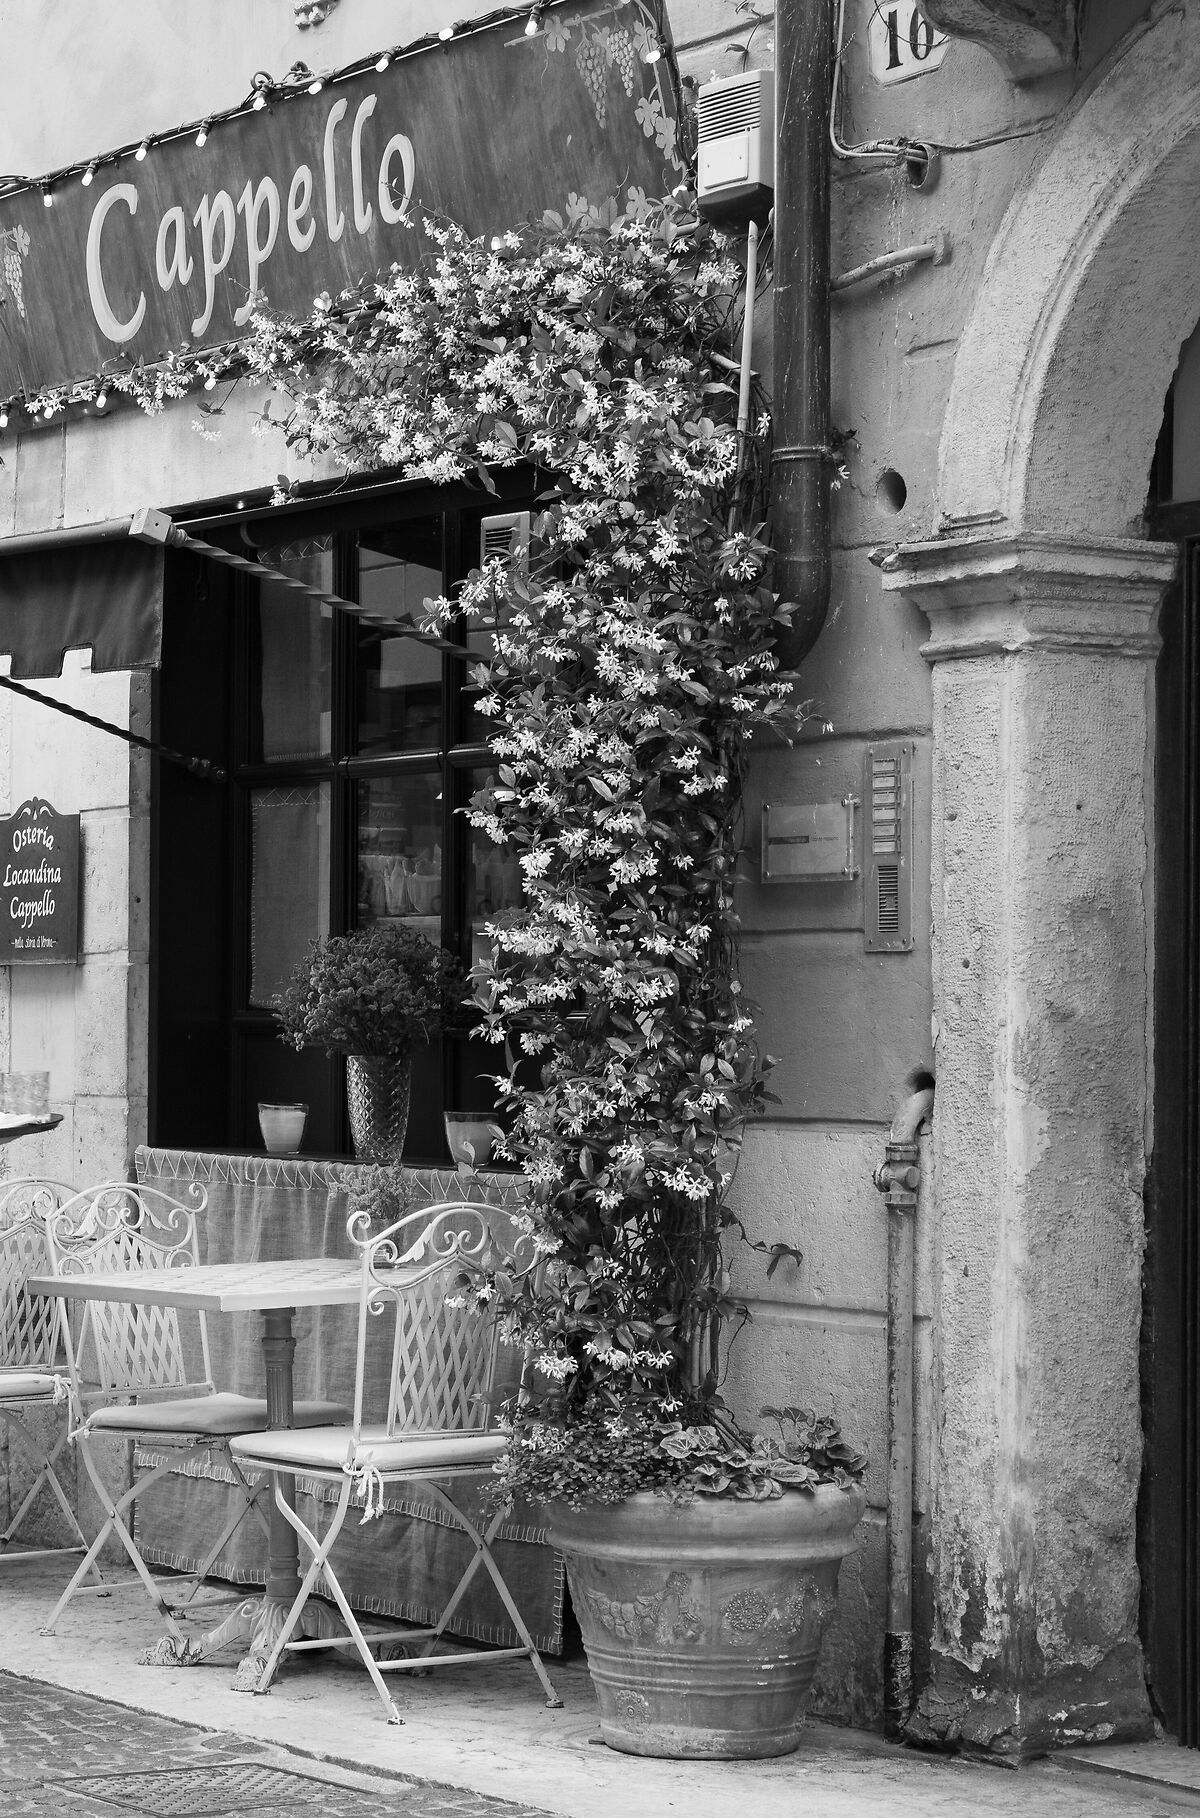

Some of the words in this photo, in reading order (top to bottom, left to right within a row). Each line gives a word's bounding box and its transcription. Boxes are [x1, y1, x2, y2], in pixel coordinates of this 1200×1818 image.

[86, 94, 416, 343] Cappello
[13, 825, 54, 852] Osteria
[3, 858, 62, 887] Locandina
[10, 889, 56, 929] Cappello
